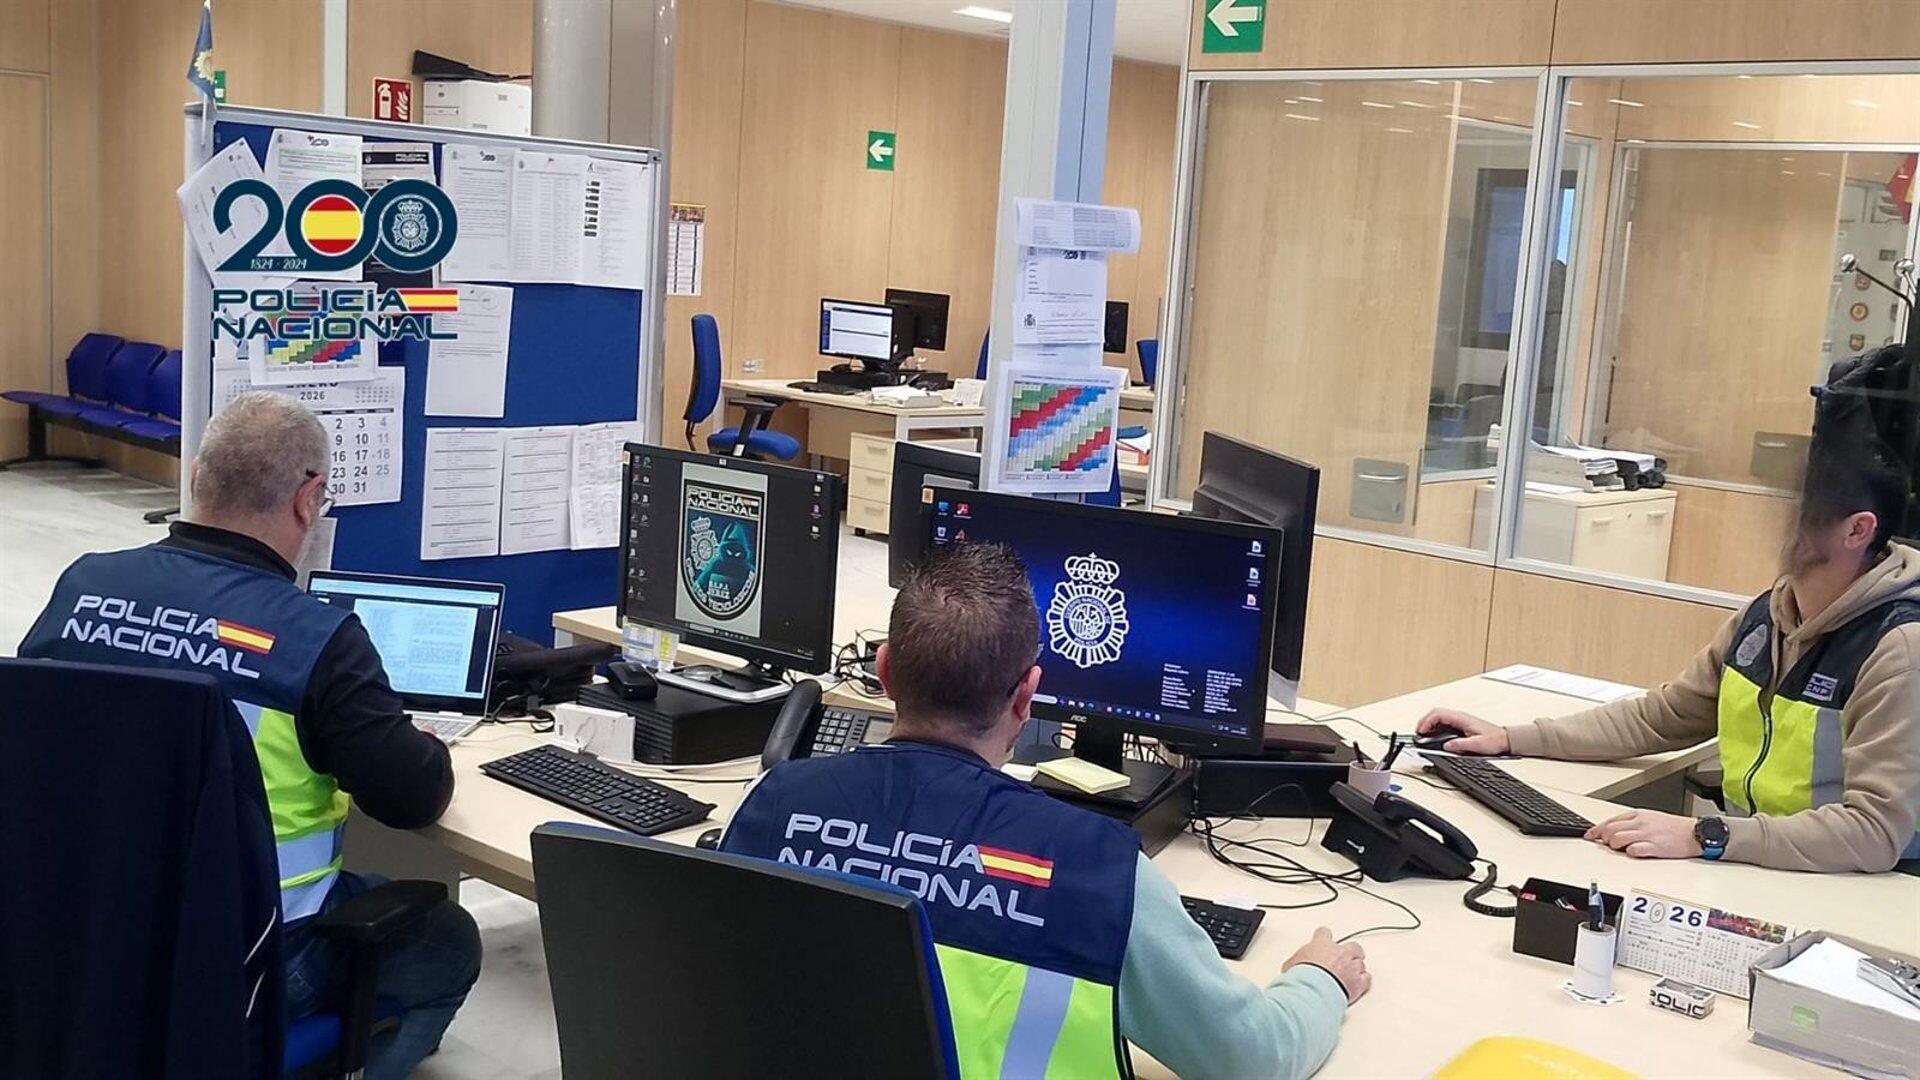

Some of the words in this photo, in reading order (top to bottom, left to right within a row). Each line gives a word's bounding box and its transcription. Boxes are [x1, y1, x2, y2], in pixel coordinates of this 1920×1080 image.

[300, 391, 325, 400] 2026
[335, 418, 343, 430] 2
[357, 417, 366, 429] 3
[379, 417, 387, 428] 4
[335, 434, 343, 446] 9
[355, 433, 369, 445] 10
[378, 433, 389, 443] 11
[331, 451, 346, 462] 16
[354, 449, 368, 461] 17
[377, 449, 390, 460] 18
[331, 467, 346, 478] 23
[353, 466, 368, 477] 24
[375, 465, 390, 476] 25
[331, 483, 346, 494] 30
[353, 482, 367, 493] 31
[688, 498, 759, 517] NACIONAL
[61, 618, 260, 678] NACIONAL
[778, 847, 1045, 927] NACIONAL
